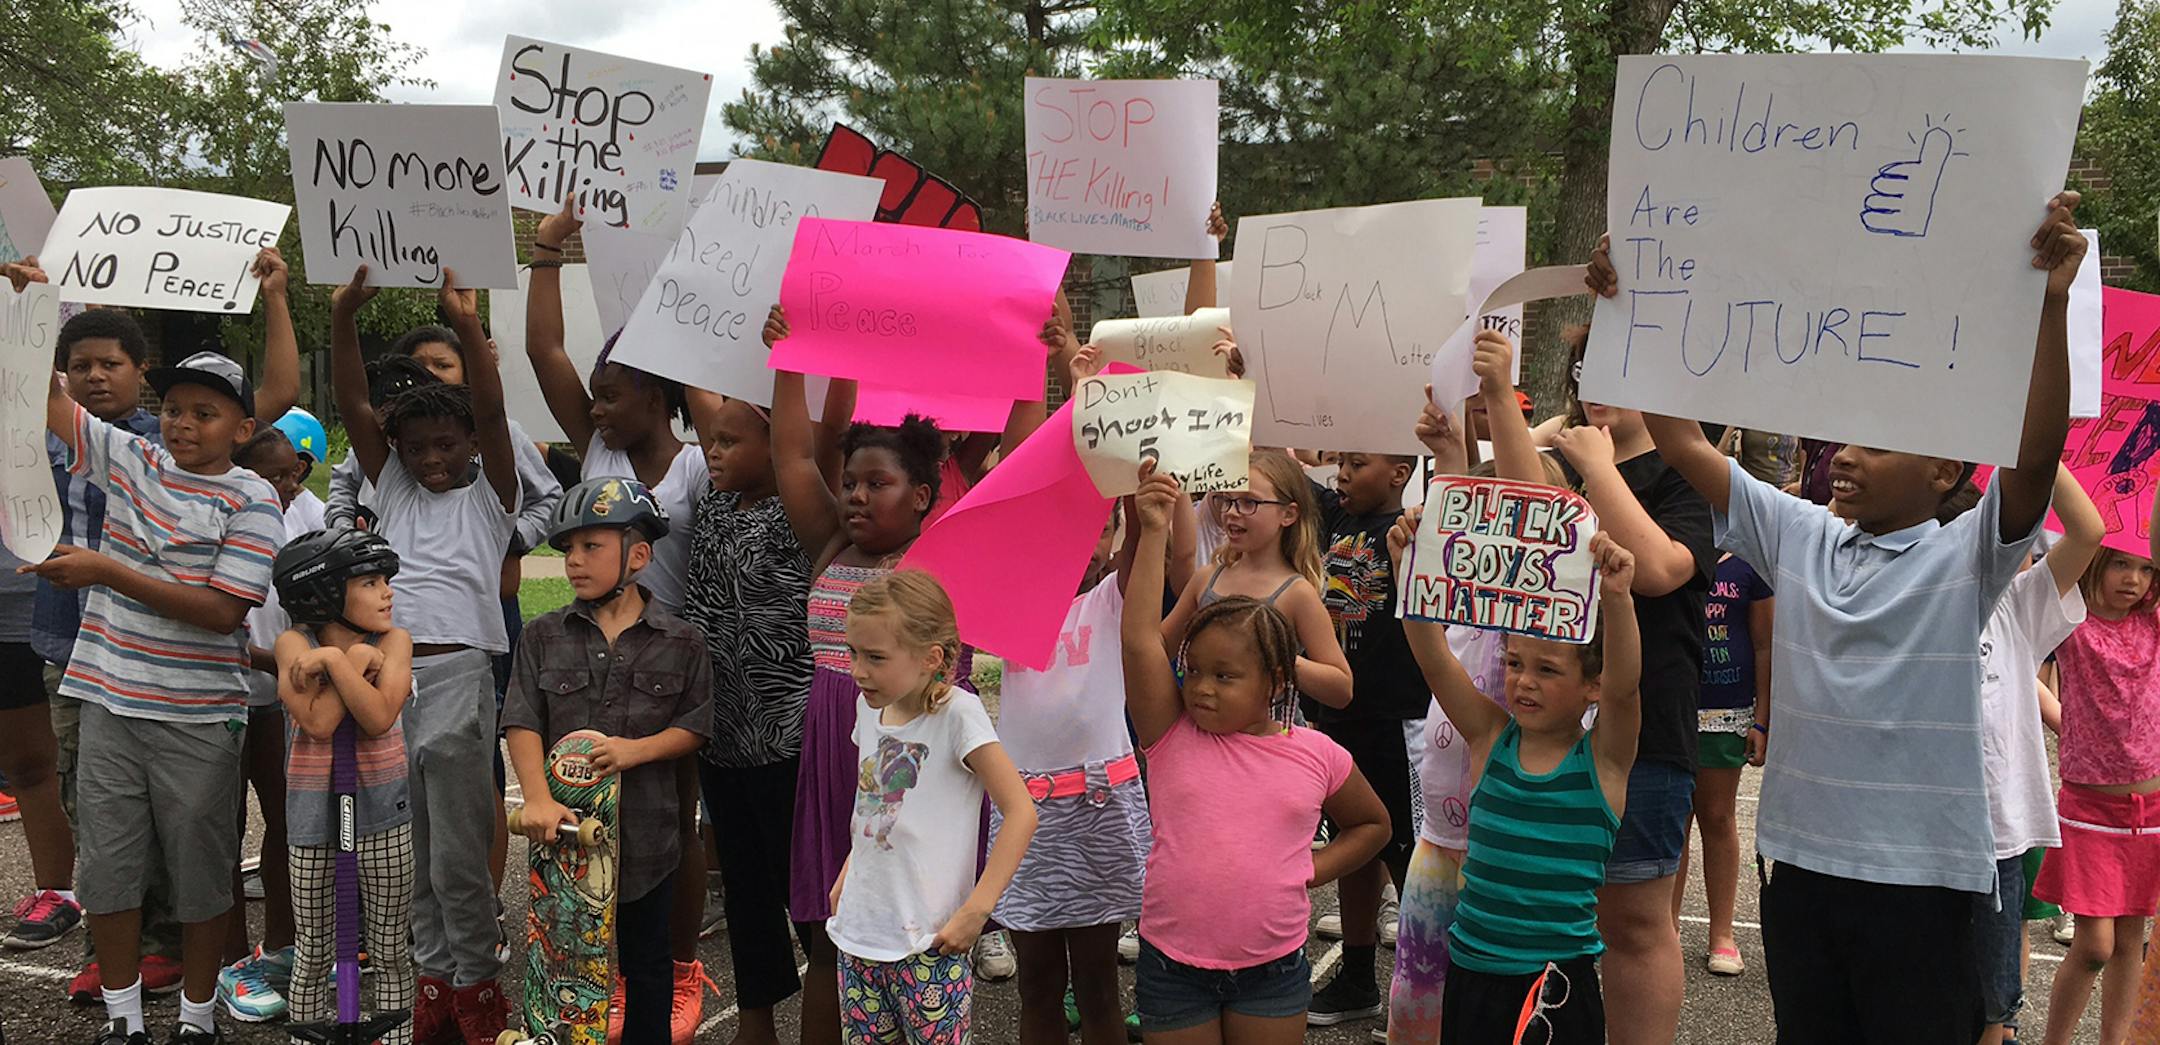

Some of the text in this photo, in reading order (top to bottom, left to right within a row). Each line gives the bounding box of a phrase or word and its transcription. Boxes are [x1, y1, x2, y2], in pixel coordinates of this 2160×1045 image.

[510, 44, 655, 144] Stop
[1035, 86, 1155, 148] STOP
[1635, 64, 1859, 153] Children
[313, 137, 376, 190] NO
[545, 127, 625, 172] the
[1029, 151, 1080, 200] THE
[504, 136, 629, 227] Killing
[1630, 185, 1699, 227] Are
[78, 211, 141, 238] NO
[329, 198, 439, 284] Killing
[811, 223, 920, 261] March
[1033, 206, 1068, 226] BLACK
[1071, 213, 1109, 226] LIVES
[60, 250, 118, 290] NO
[1258, 223, 1323, 311] Black
[1626, 238, 1696, 280] The
[809, 271, 917, 337] Peace
[1082, 376, 1158, 410] Don't
[1260, 329, 1335, 428] Lives
[1138, 436, 1160, 476] 5
[1440, 488, 1582, 547] BLACK
[1450, 539, 1550, 593] BOYS
[1413, 576, 1580, 640] MATTER
[1710, 646, 1731, 664] FUN
